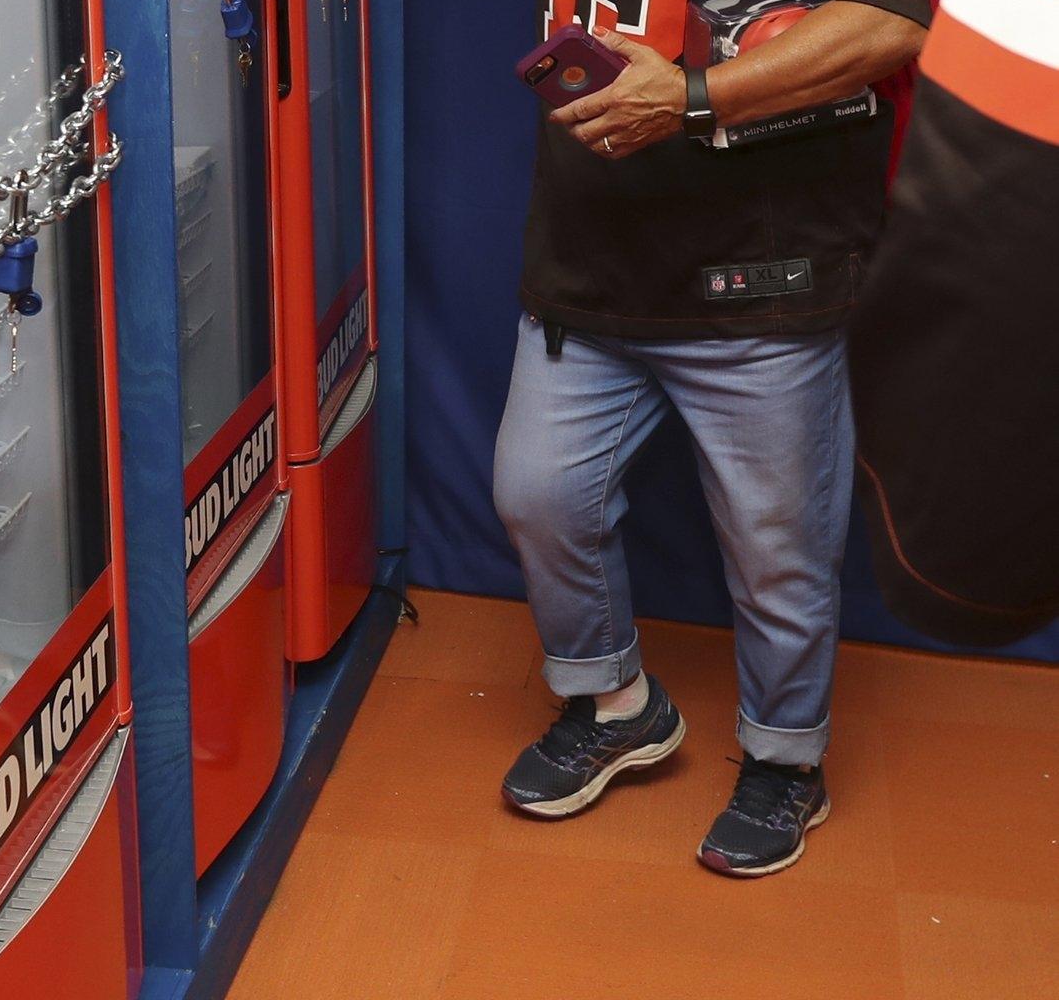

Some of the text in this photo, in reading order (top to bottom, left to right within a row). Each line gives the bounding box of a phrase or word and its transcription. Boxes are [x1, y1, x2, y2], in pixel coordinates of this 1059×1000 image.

[743, 114, 817, 137] MINI HELMET
[755, 268, 778, 281] XL
[339, 287, 369, 368] LIGHT
[222, 410, 275, 519] LIGHT
[24, 623, 109, 798] LIGHT
